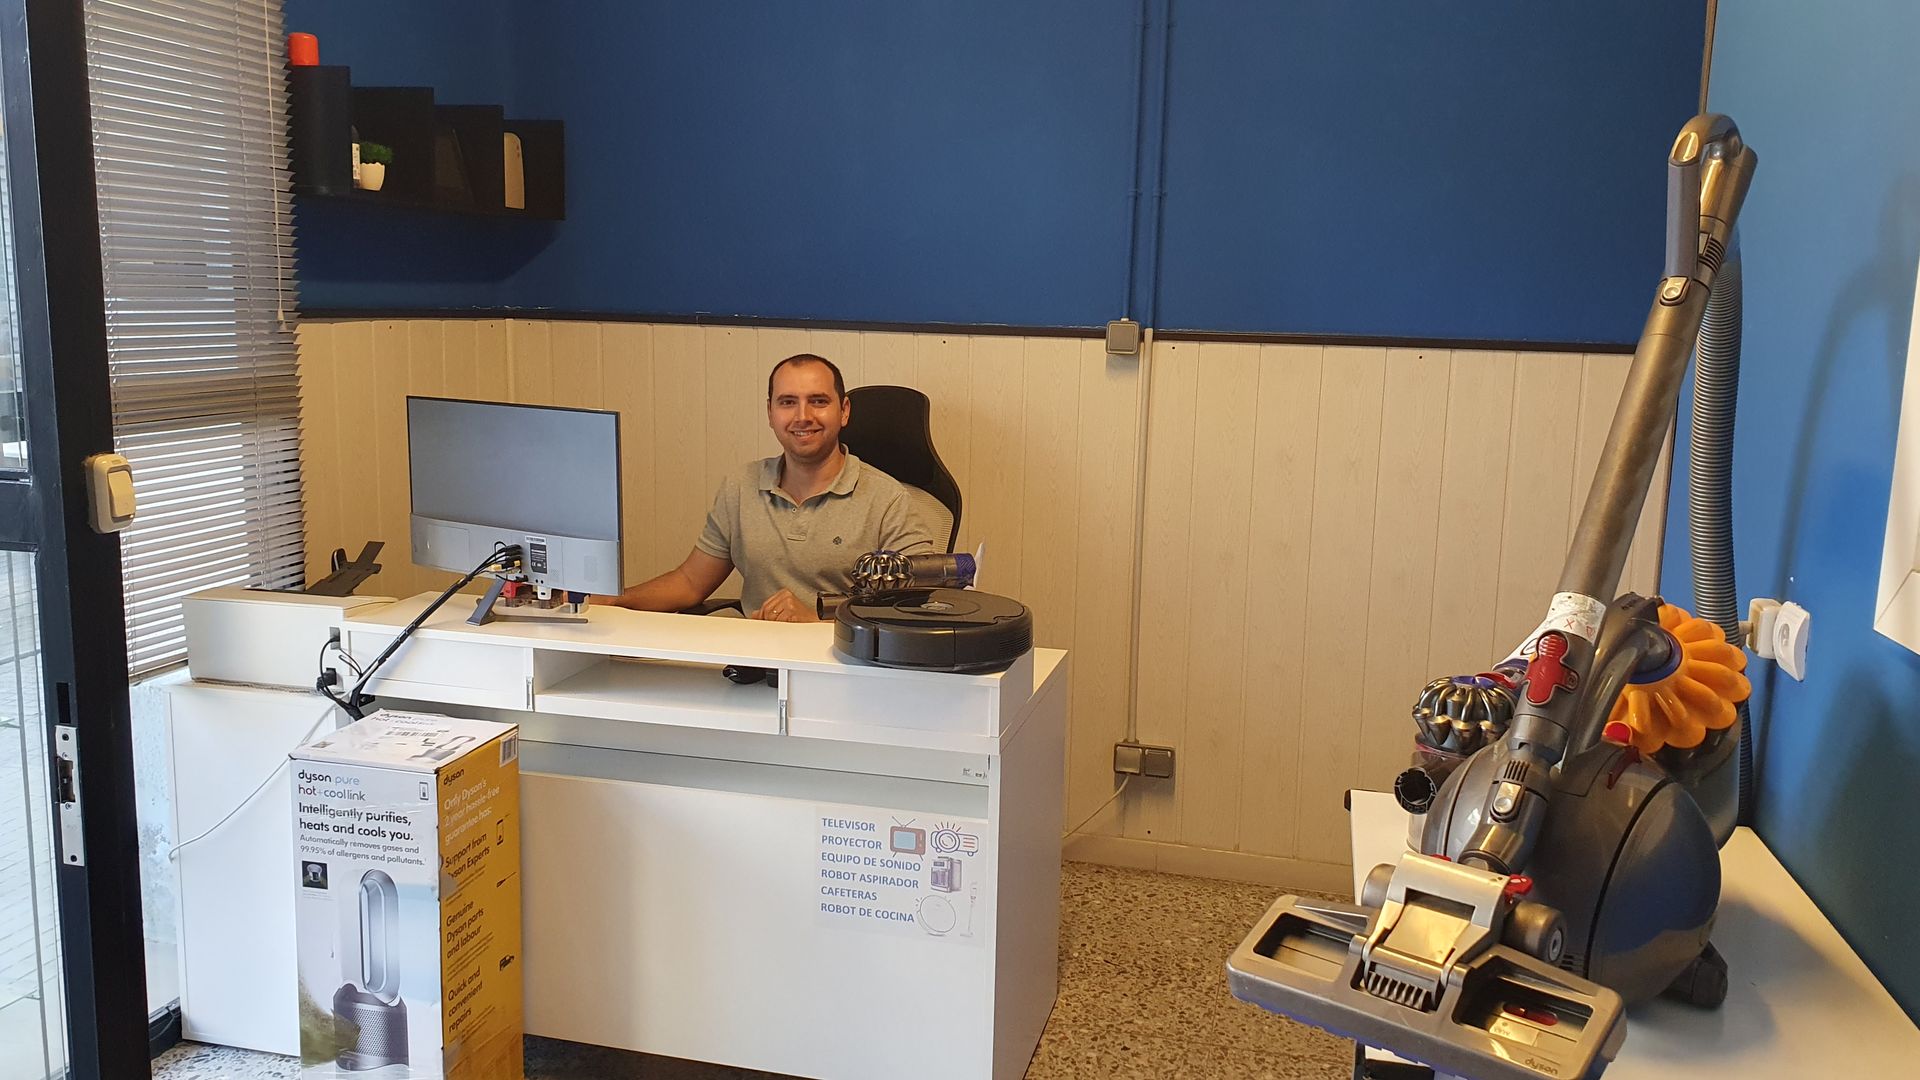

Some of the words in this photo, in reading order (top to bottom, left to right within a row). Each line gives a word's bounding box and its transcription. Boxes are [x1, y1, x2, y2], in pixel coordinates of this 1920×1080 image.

[298, 769, 332, 783] dyson
[335, 775, 360, 786] pure
[444, 768, 464, 786] dyson
[444, 793, 461, 810] Only
[299, 802, 364, 821] Intelligently
[366, 811, 412, 826] purifies,
[300, 818, 330, 832] heats
[332, 824, 354, 834] and
[358, 826, 386, 838] cools
[389, 830, 414, 842] you.
[822, 817, 875, 832] TELEVISOR
[300, 834, 348, 847] Automatically
[350, 841, 380, 850] removes
[382, 844, 403, 854] gases
[446, 842, 471, 868] Support
[472, 834, 487, 849] from
[822, 835, 882, 850] PROYECTOR
[300, 845, 326, 855] 99.95%
[336, 850, 369, 861] allergens
[371, 853, 385, 861] and
[466, 846, 490, 869] Experts
[821, 852, 861, 865] EQUIPO
[863, 856, 877, 866] DE
[879, 858, 921, 872] SONIDO
[821, 869, 857, 881] ROBOT
[859, 873, 919, 888] ASPIRADOR
[821, 886, 877, 901] CAFETERAS
[446, 901, 474, 927] Genuine
[821, 903, 857, 915] ROBOT
[859, 907, 872, 918] DE
[875, 909, 914, 923] COCINA
[446, 921, 467, 944] Dyson
[468, 908, 484, 929] parts
[447, 941, 460, 958] and
[460, 925, 482, 948] labour
[448, 978, 467, 1001] Quick
[468, 965, 480, 984] and
[448, 980, 483, 1017] convenient
[449, 1008, 472, 1033] repairs
[1525, 1058, 1558, 1075] dyson
